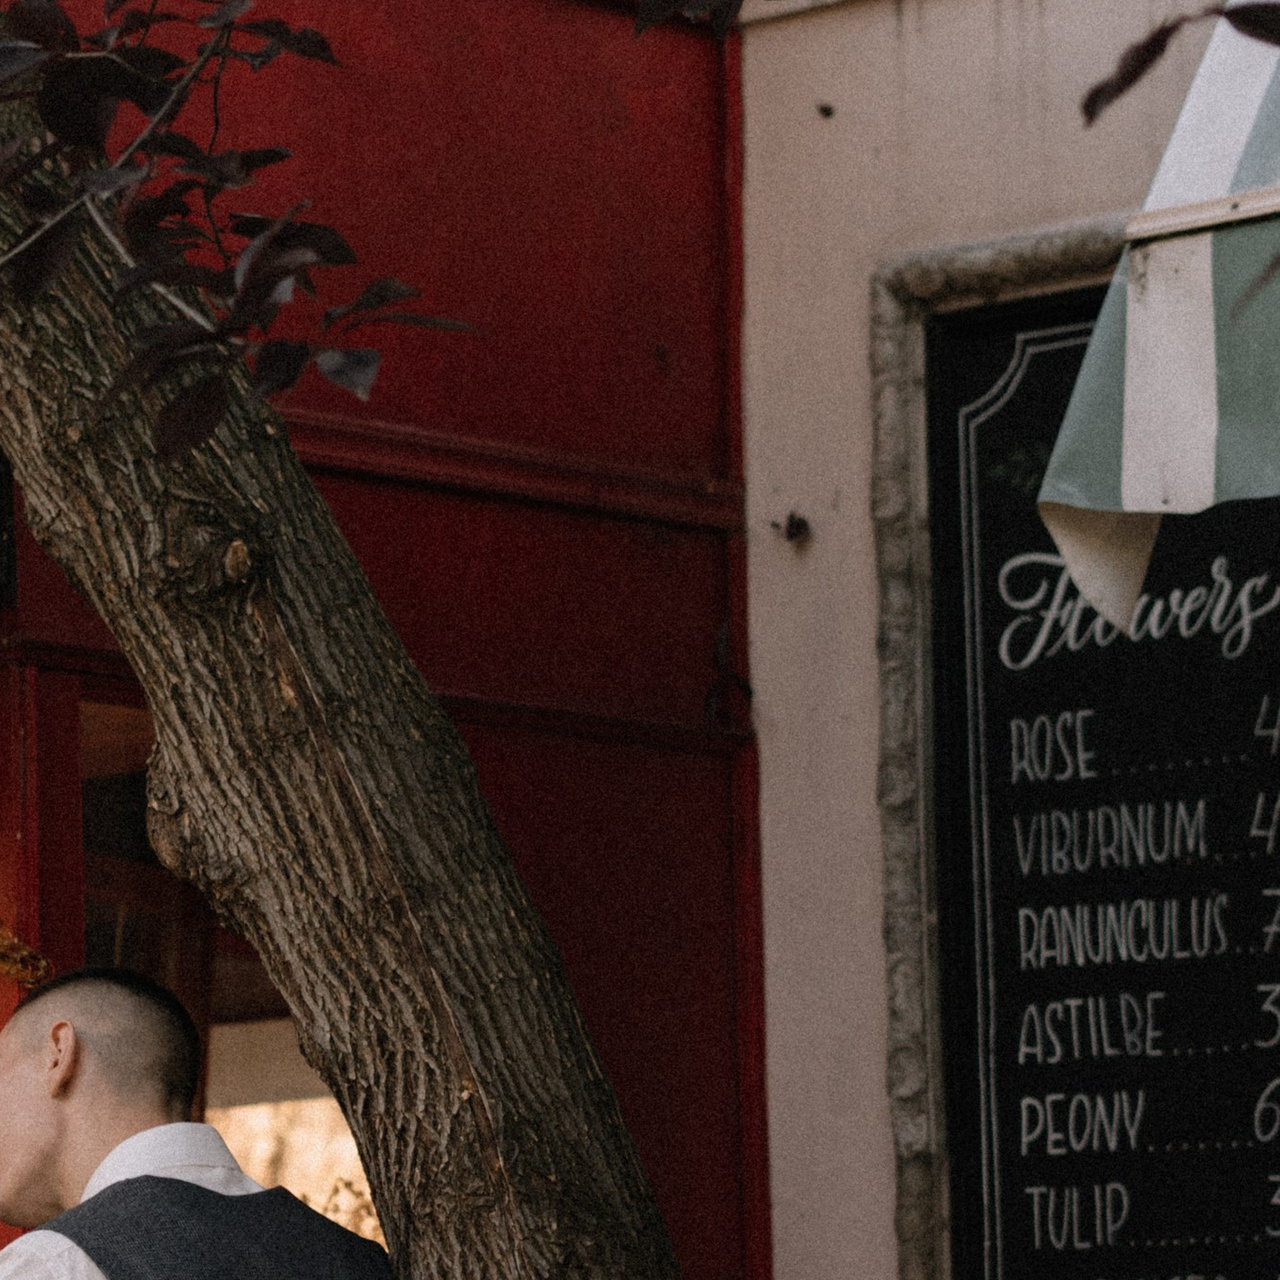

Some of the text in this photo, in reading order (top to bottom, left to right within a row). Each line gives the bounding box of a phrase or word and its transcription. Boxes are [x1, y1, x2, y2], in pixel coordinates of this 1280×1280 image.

[1010, 708, 1098, 785] ROSE
[1013, 798, 1208, 877] VIBURNUM
[1019, 894, 1229, 971] RANUNCULUS
[1019, 990, 1167, 1065] ASTILBE
[1020, 1089, 1146, 1156] PEONY
[1024, 1182, 1131, 1250] TULIP
